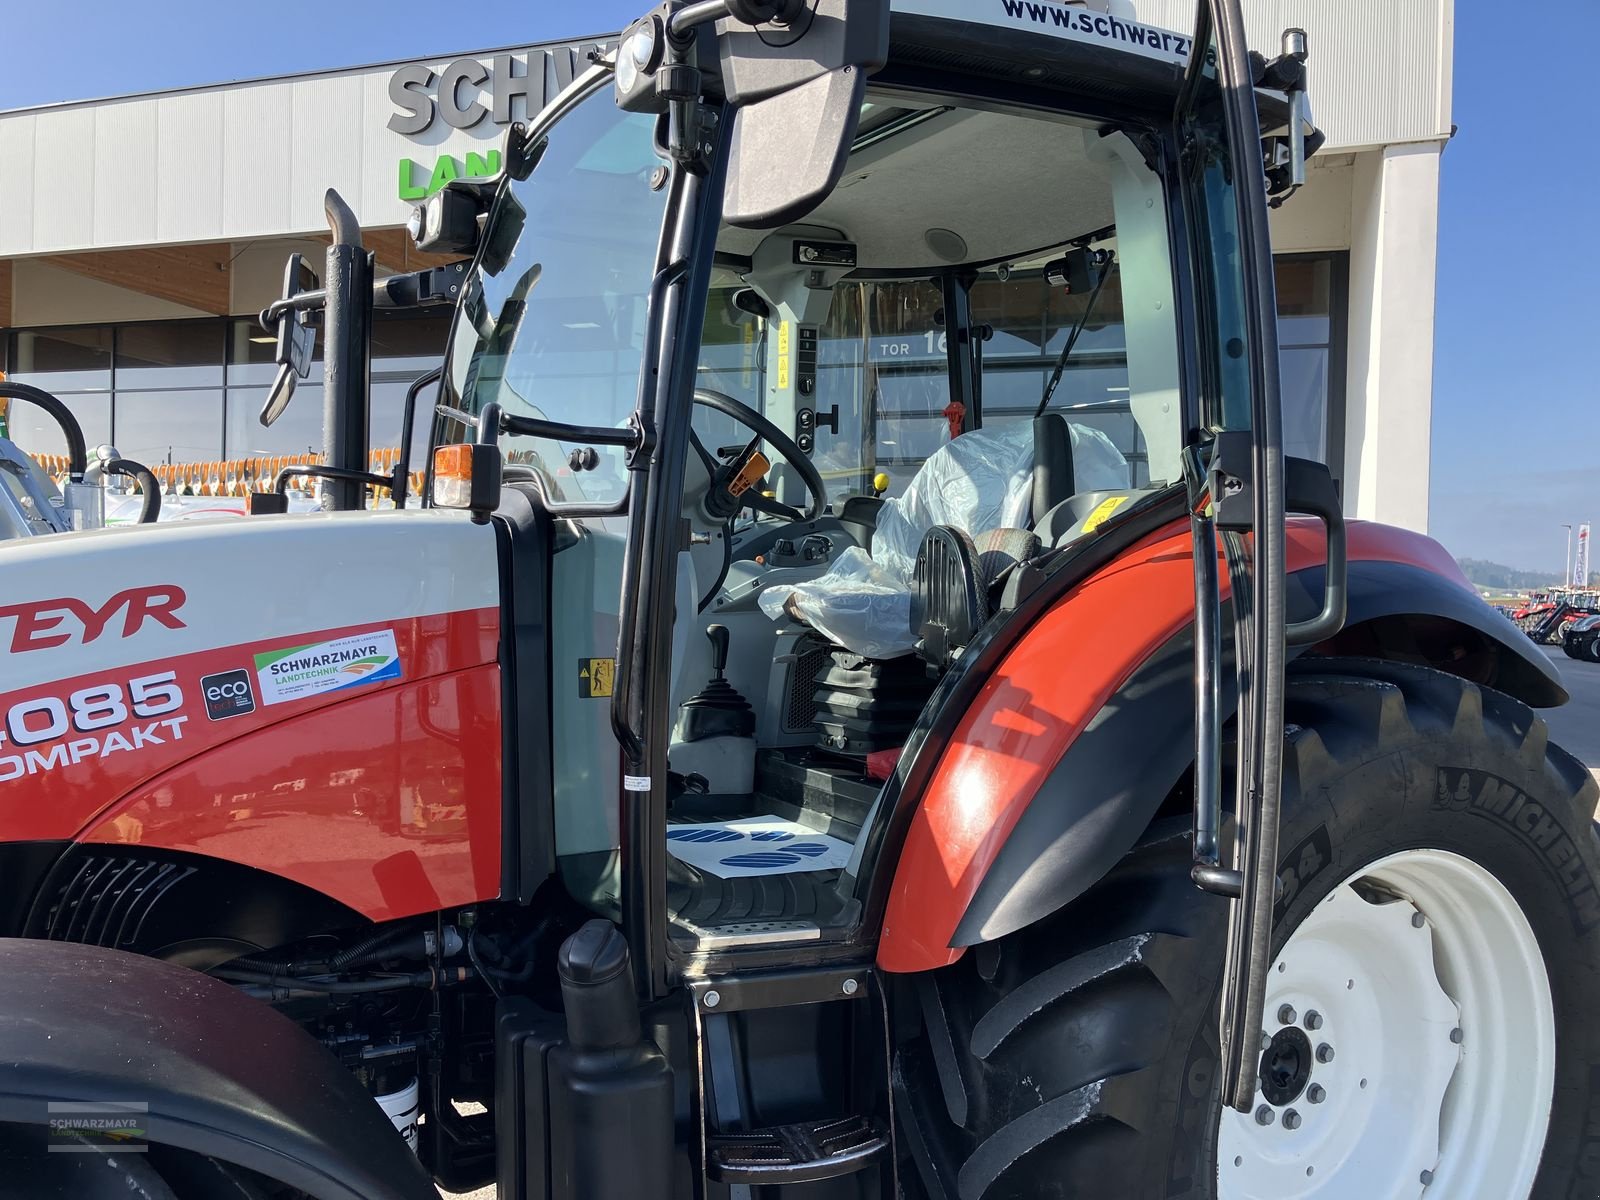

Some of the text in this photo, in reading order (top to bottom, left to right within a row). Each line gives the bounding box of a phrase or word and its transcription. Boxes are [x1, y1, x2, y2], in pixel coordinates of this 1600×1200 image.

[880, 343, 909, 356] TOR
[0, 584, 188, 653] EYR
[270, 645, 378, 675] SCHWARZMAYR
[275, 666, 339, 685] LANDTECHNIK
[207, 681, 248, 701] eco
[0, 671, 184, 749] 085
